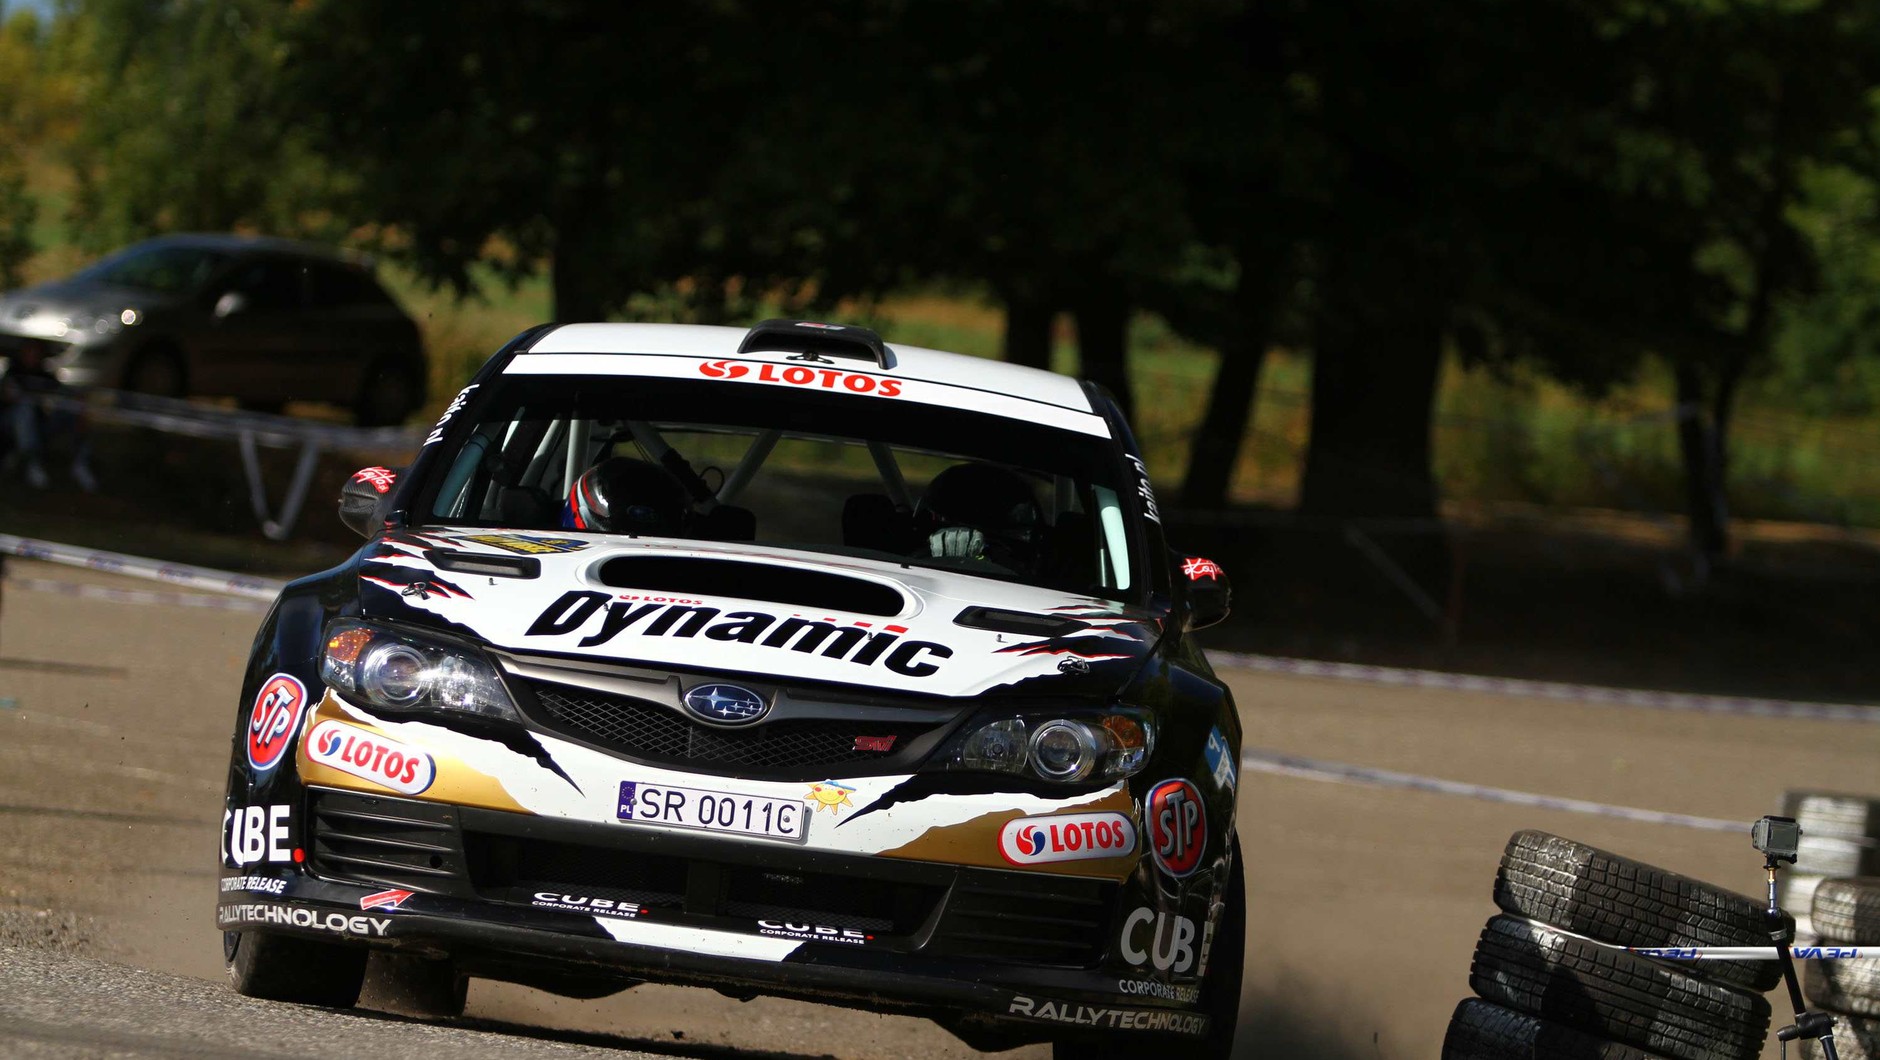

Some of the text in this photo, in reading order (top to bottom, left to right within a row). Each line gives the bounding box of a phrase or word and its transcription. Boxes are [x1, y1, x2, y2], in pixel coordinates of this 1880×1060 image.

[758, 363, 903, 397] LOTOS
[1124, 452, 1162, 526] kajtopl
[643, 596, 703, 605] LOTOS
[524, 590, 953, 678] Dynamic
[252, 684, 296, 747] STP
[340, 735, 420, 785] LOTOS
[619, 804, 632, 814] PL
[640, 788, 797, 834] SR 0011C
[1160, 789, 1199, 857] STP
[1049, 820, 1126, 853] LOTOS
[221, 876, 287, 894] CORPORATE RELEASE
[219, 903, 393, 936] RALLYTECHNOLOGY
[531, 900, 637, 918] CORPORATE RELEASE
[759, 928, 865, 945] CORPORATE RELEASE
[1793, 947, 1858, 959] PEVA
[1118, 979, 1175, 1000] CORPORATE
[1009, 995, 1206, 1036] RALLYTECHNOLOGY
